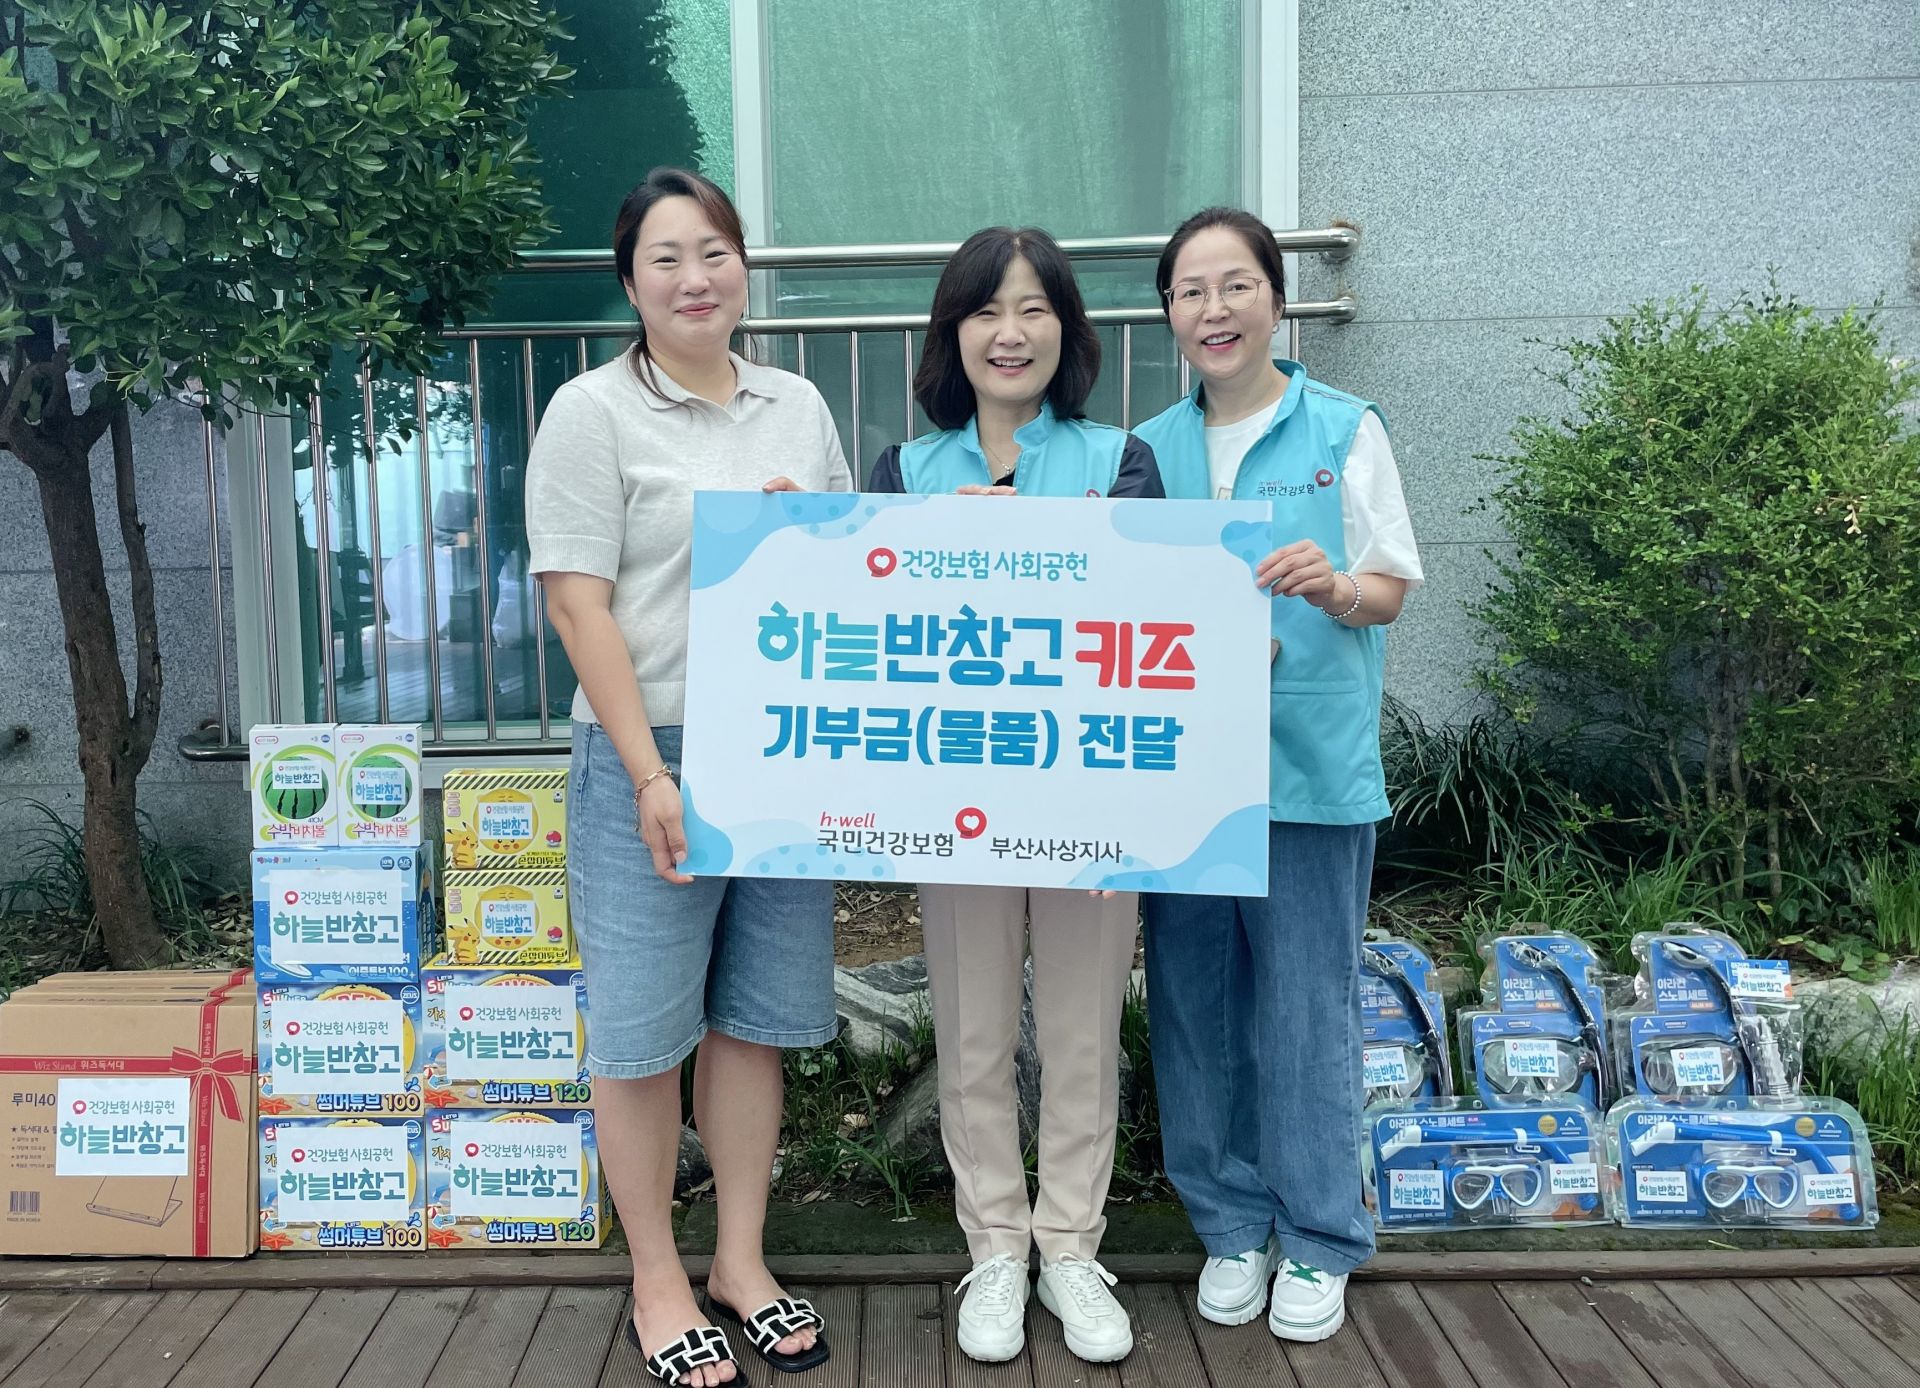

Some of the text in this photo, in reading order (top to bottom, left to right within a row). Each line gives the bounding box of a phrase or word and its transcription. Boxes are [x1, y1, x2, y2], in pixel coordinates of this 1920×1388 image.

[1257, 484, 1315, 496] 국민건강보험
[902, 550, 1088, 582] 건강보험 사회공헌
[757, 601, 1196, 690] 하늘반창고 키즈
[763, 705, 1184, 771] 기부금(물품) 전달
[274, 773, 320, 784] 하늘반창고
[355, 782, 402, 801] 하늘반창고
[267, 822, 326, 839] 수박비치볼
[352, 822, 409, 839] 수박비치볼
[482, 817, 530, 836] 하늘반창고
[817, 829, 954, 857] 국민건강보험
[990, 836, 1123, 864] 부산사상지사
[301, 891, 387, 905] 건강보험 사회공헌
[273, 911, 399, 944] 하늘반창고
[485, 915, 532, 934] 하늘반창고
[1741, 980, 1782, 992] 하늘반창고
[476, 1007, 562, 1020] 건강보험 사회공헌
[302, 1022, 388, 1035] 건강보험 사회공헌
[448, 1027, 574, 1059] 하늘반창고
[275, 1042, 400, 1074] 하늘반창고
[1509, 1053, 1556, 1073] 하늘반창고
[1363, 1061, 1406, 1083] 하늘반창고
[1677, 1062, 1721, 1082] 하늘반창고
[482, 1082, 591, 1103] 썸머튜브 120
[88, 1100, 175, 1115] 건강보험 사회공헌
[317, 1094, 420, 1112] 썸머튜브 100
[60, 1121, 185, 1154] 하늘반창고
[308, 1148, 393, 1162] 건강보험 사회공헌
[481, 1144, 567, 1159] 건강보험 사회공헌
[280, 1168, 405, 1201] 하늘반창고
[453, 1163, 578, 1197] 하늘반창고
[1553, 1176, 1596, 1189] 하늘반창고
[1393, 1185, 1440, 1205] 하늘반창고
[1639, 1184, 1685, 1196] 하늘반창고
[1807, 1187, 1853, 1199] 하늘반창고
[317, 1227, 422, 1246] 썸머튜브 100
[486, 1222, 596, 1242] 썸머튜브 120
